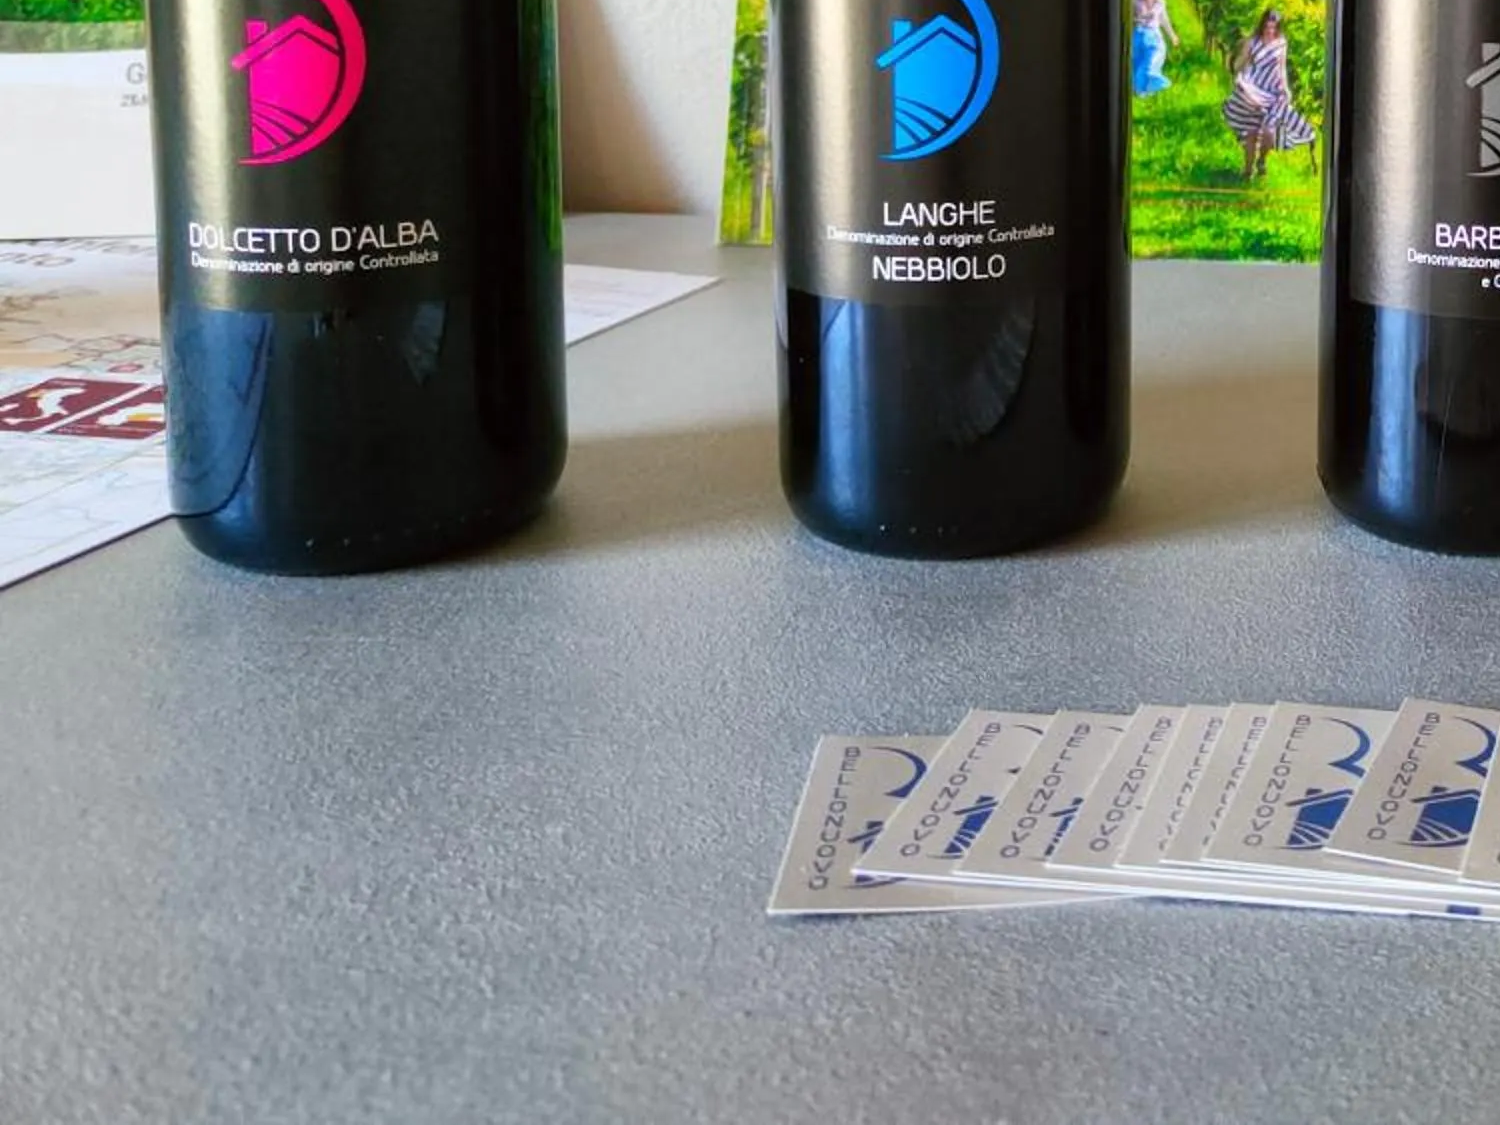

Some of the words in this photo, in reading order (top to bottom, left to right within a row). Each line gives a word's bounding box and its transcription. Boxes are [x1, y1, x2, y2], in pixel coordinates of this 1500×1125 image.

[883, 200, 996, 227] LANGHE
[188, 222, 321, 254] DOLCETTO
[331, 218, 440, 252] D'ALBA
[923, 232, 935, 246] di
[939, 231, 984, 248] origine
[987, 223, 1055, 243] Controllata
[287, 258, 300, 274] di
[305, 258, 355, 275] origine
[360, 249, 440, 271] Controllata
[872, 253, 1007, 282] NEBBIOLO
[1406, 247, 1500, 270] Denominazione
[1481, 277, 1491, 289] e
[900, 722, 1002, 858] BELLONUOVO
[1243, 714, 1311, 847] BELLONUOVO
[1367, 712, 1441, 841] BELLONUOVO
[808, 746, 862, 891] BELLONUOVO
